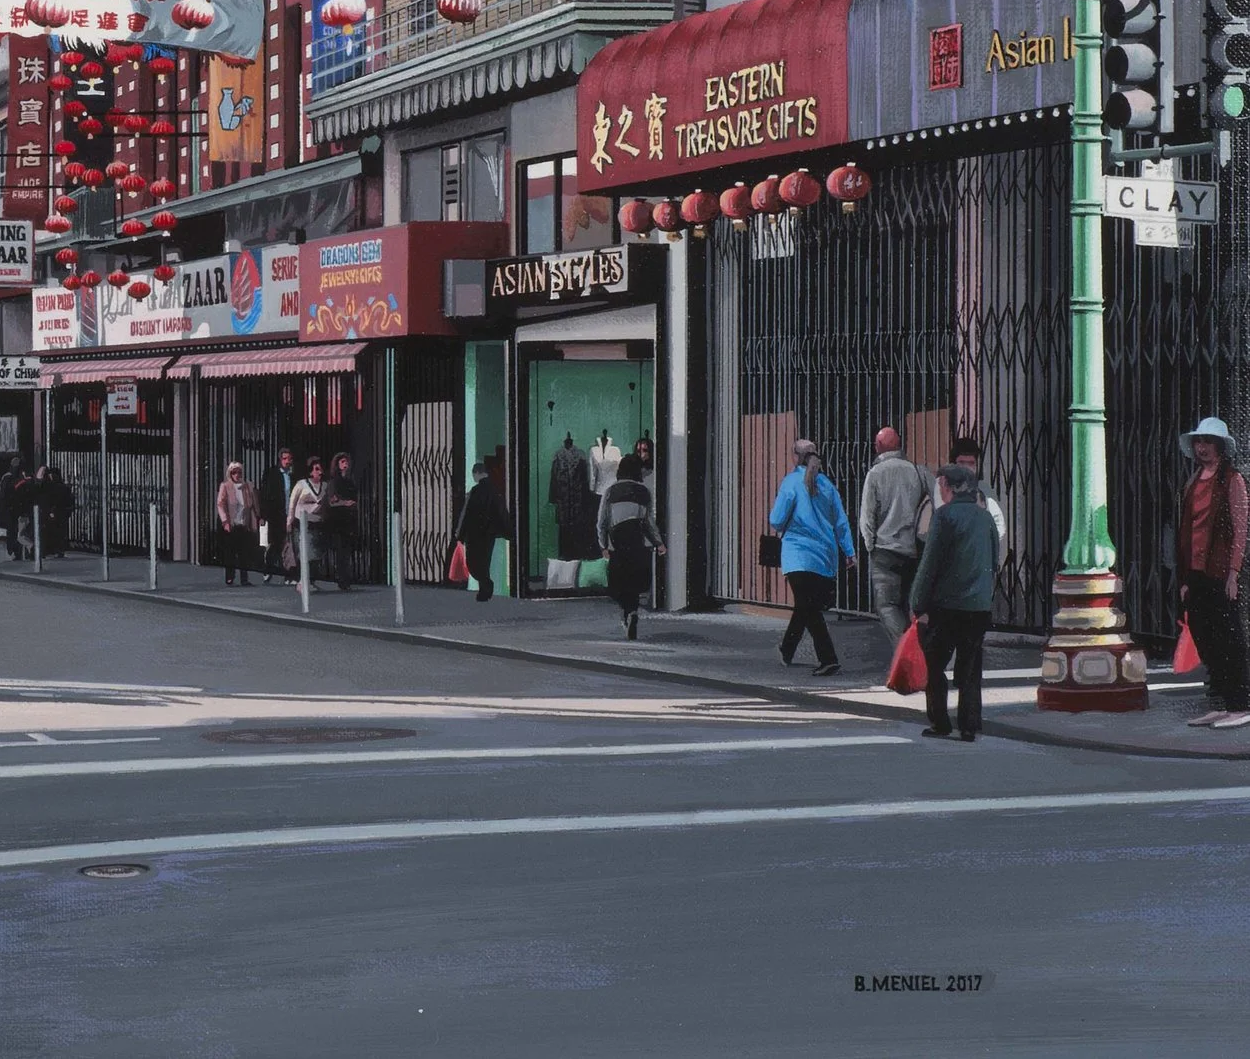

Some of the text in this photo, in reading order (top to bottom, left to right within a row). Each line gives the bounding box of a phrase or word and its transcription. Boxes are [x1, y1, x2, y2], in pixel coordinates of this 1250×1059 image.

[985, 28, 1055, 74] Asian
[705, 59, 785, 112] EASTERN
[15, 56, 46, 169] 珠寶店
[674, 96, 818, 159] TREASURE GIFTS
[1118, 186, 1209, 216] CLAY
[492, 261, 547, 297] ASIAN
[854, 974, 983, 992] B.MENIEL 2017
